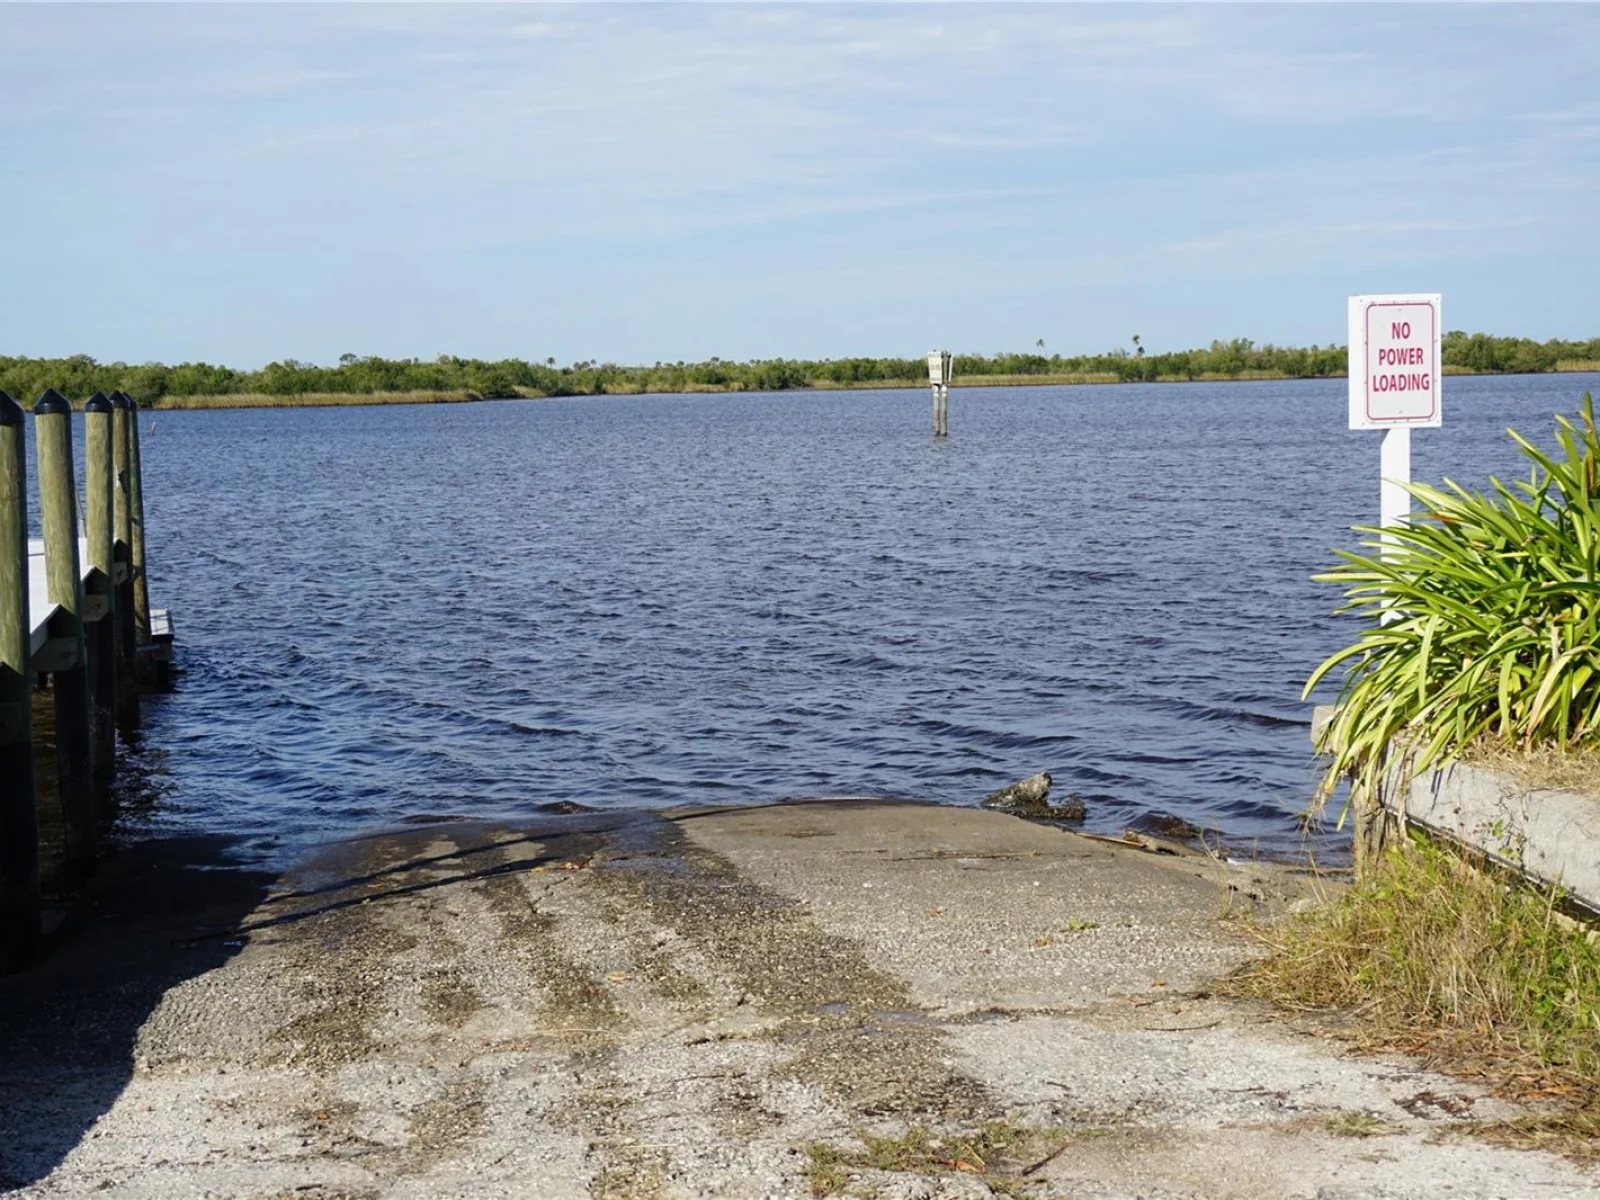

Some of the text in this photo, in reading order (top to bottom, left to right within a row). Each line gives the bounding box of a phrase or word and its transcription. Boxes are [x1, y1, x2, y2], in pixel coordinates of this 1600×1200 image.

[1391, 322, 1411, 339] NO
[1378, 347, 1424, 366] POWER
[1372, 373, 1430, 392] LOADING
